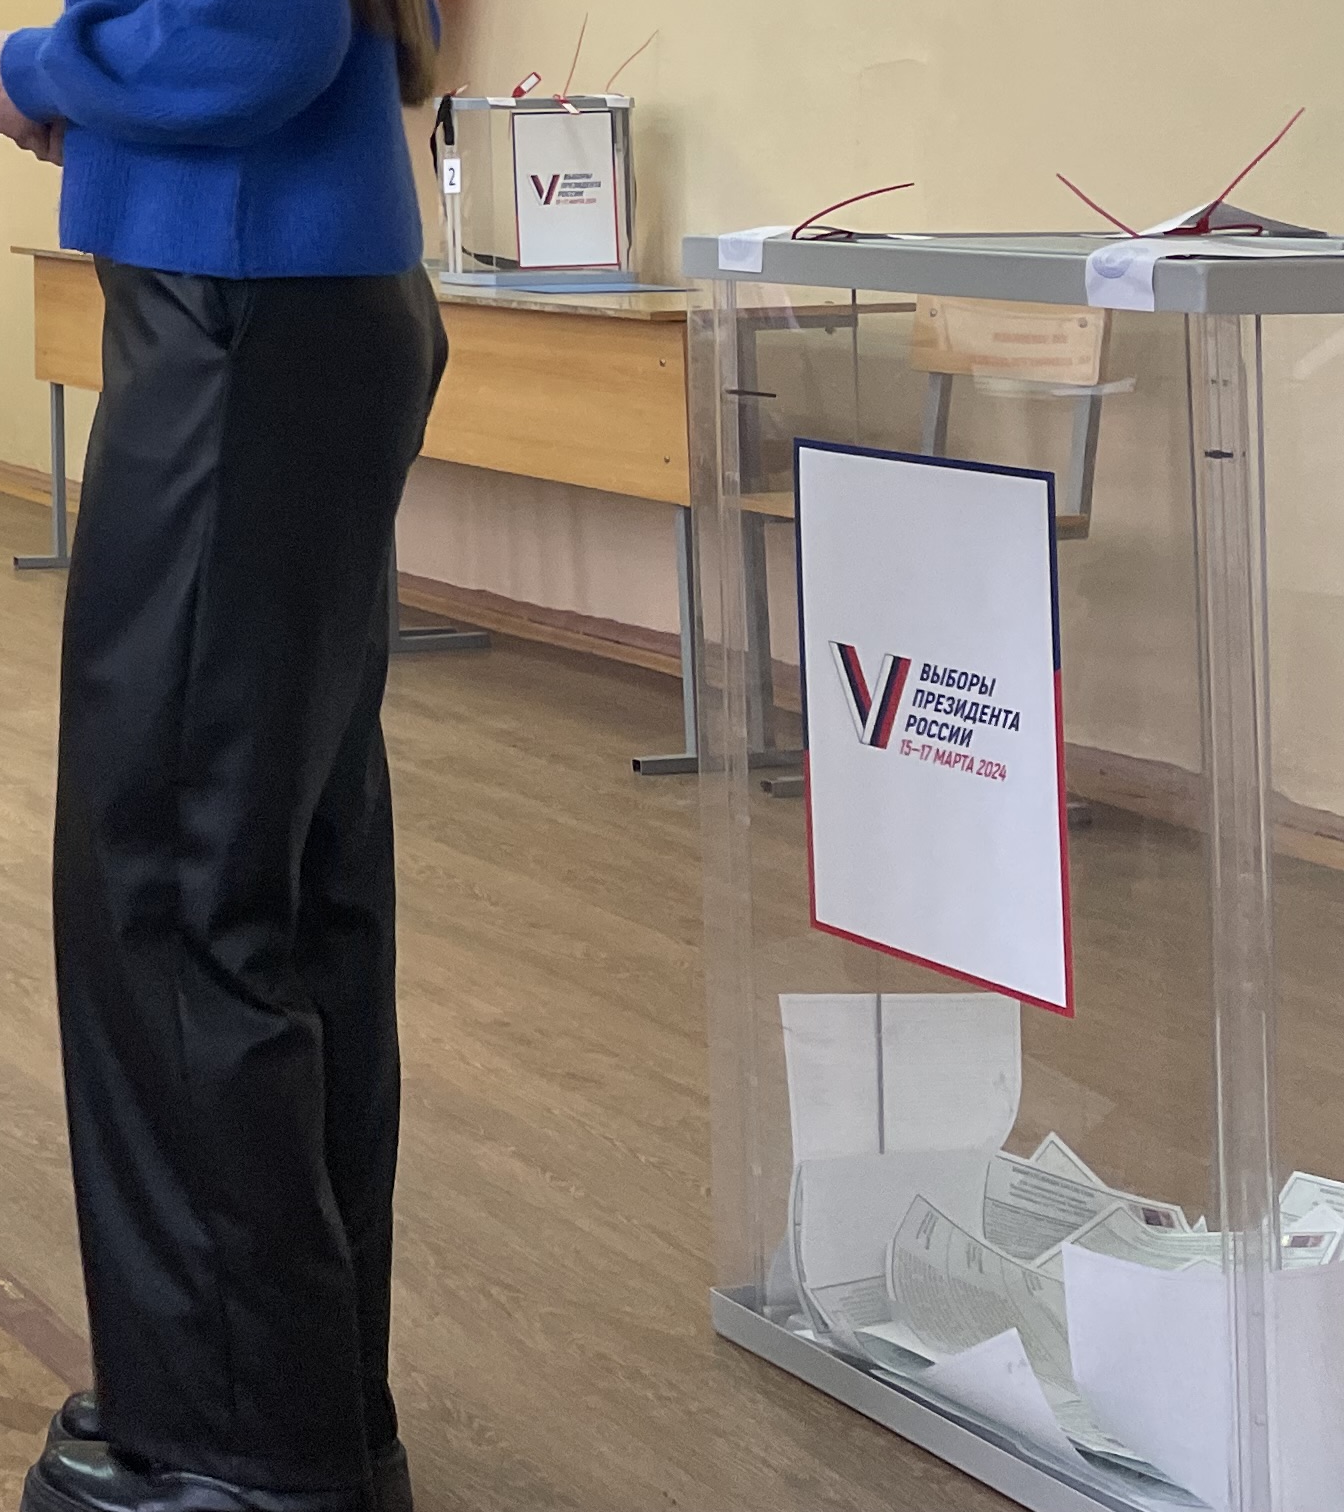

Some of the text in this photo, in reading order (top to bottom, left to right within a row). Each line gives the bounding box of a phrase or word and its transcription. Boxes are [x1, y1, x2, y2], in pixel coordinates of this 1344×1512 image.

[448, 167, 456, 186] 2
[919, 662, 996, 697] ВЫБОРЫ
[912, 688, 1021, 732] ПРЕЗИДЕНТА
[904, 714, 974, 748] РОССИИ
[933, 747, 975, 774] МАРТА
[976, 759, 1007, 782] 2024
